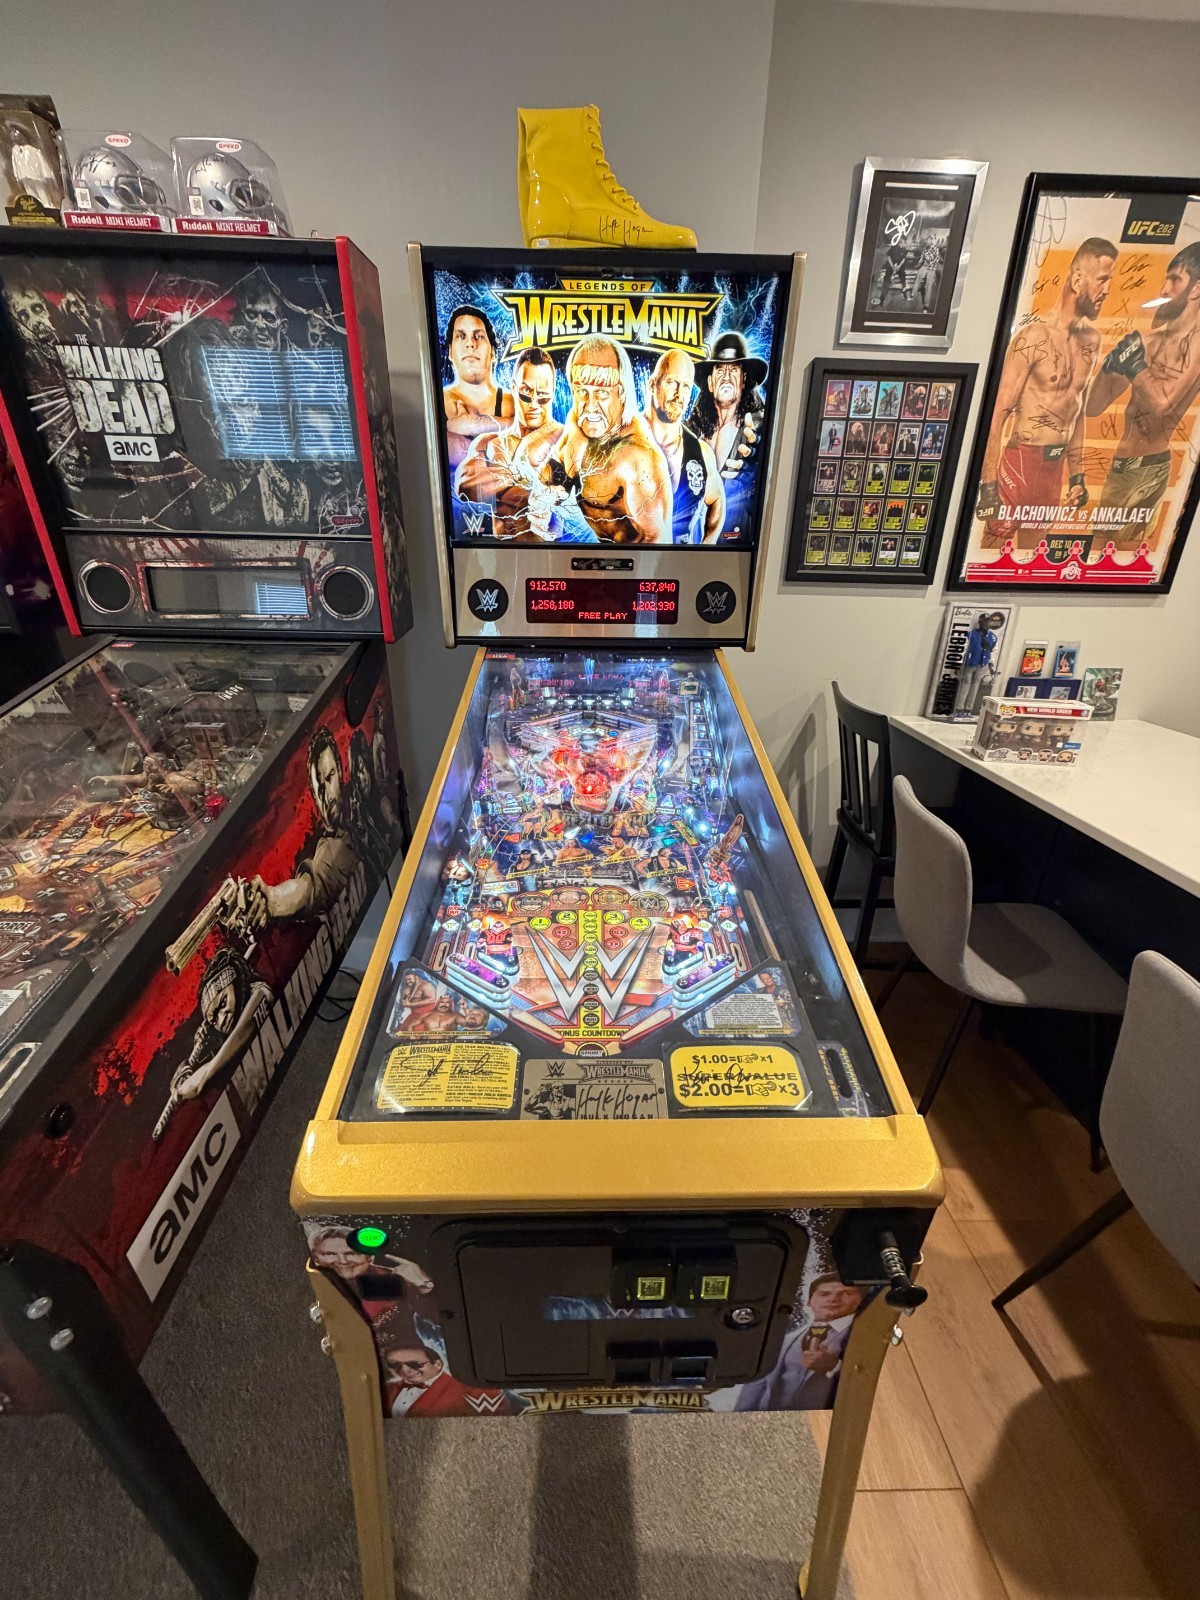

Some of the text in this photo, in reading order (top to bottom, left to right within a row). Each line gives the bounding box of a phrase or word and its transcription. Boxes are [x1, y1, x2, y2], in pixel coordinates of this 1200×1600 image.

[107, 137, 129, 145] SPEED
[71, 214, 152, 228] Riddell MINI HELMET
[182, 220, 261, 233] Riddell MINI HELMET
[1127, 220, 1160, 236] UFC
[569, 281, 647, 291] LEGENDS OF
[506, 297, 708, 354] WRESTLEMANIA
[75, 333, 89, 346] THE
[1119, 340, 1139, 363] UFC
[55, 345, 164, 381] WALKING
[66, 379, 175, 435] DEAD
[997, 505, 1075, 522] BLACHOWICZ
[1089, 507, 1155, 523] ANKALAEV
[1051, 523, 1087, 531] HEAVYWEIGHT
[1087, 523, 1125, 531] CHAMPIONSHIP
[1050, 539, 1063, 549] DEC
[530, 581, 567, 592] 912,570
[639, 582, 676, 593] 637,840
[531, 600, 575, 611] 1,258,180
[632, 601, 675, 611] 1,202,930
[578, 612, 628, 620] FREE PLAY
[944, 622, 970, 671] LEBRON
[328, 865, 369, 954] DEAD
[252, 997, 271, 1029] THE
[233, 926, 332, 1116] WALKING
[586, 1064, 650, 1079] WRESTLEMANIA
[531, 1390, 702, 1412] WRESTLEMANIA
